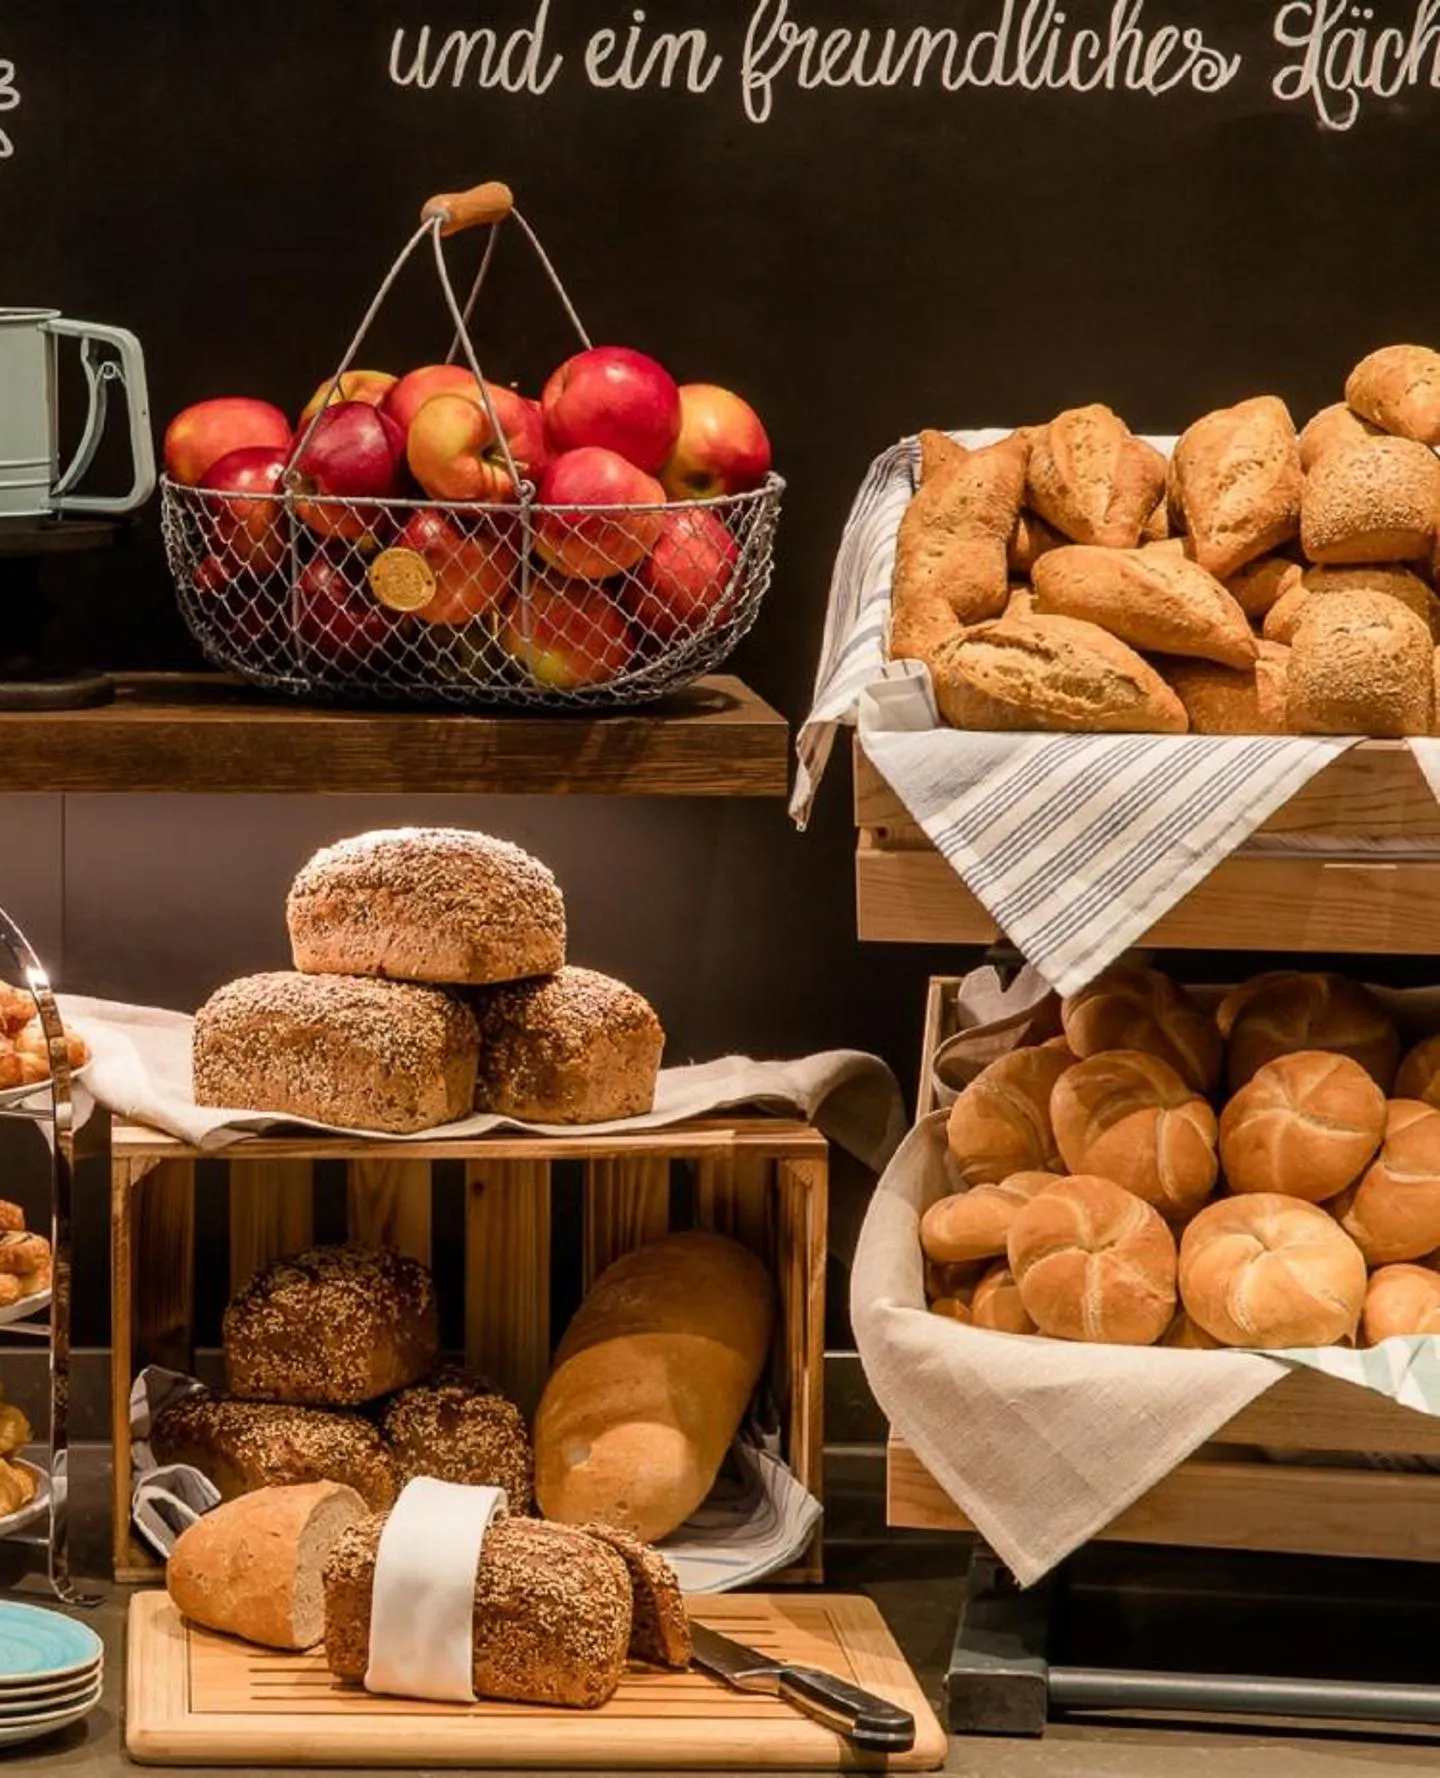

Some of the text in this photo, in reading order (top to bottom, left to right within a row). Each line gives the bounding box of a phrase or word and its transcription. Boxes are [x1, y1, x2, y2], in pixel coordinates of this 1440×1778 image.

[389, 0, 563, 95] und
[584, 9, 723, 94] ein
[741, 0, 1242, 124] freundliches
